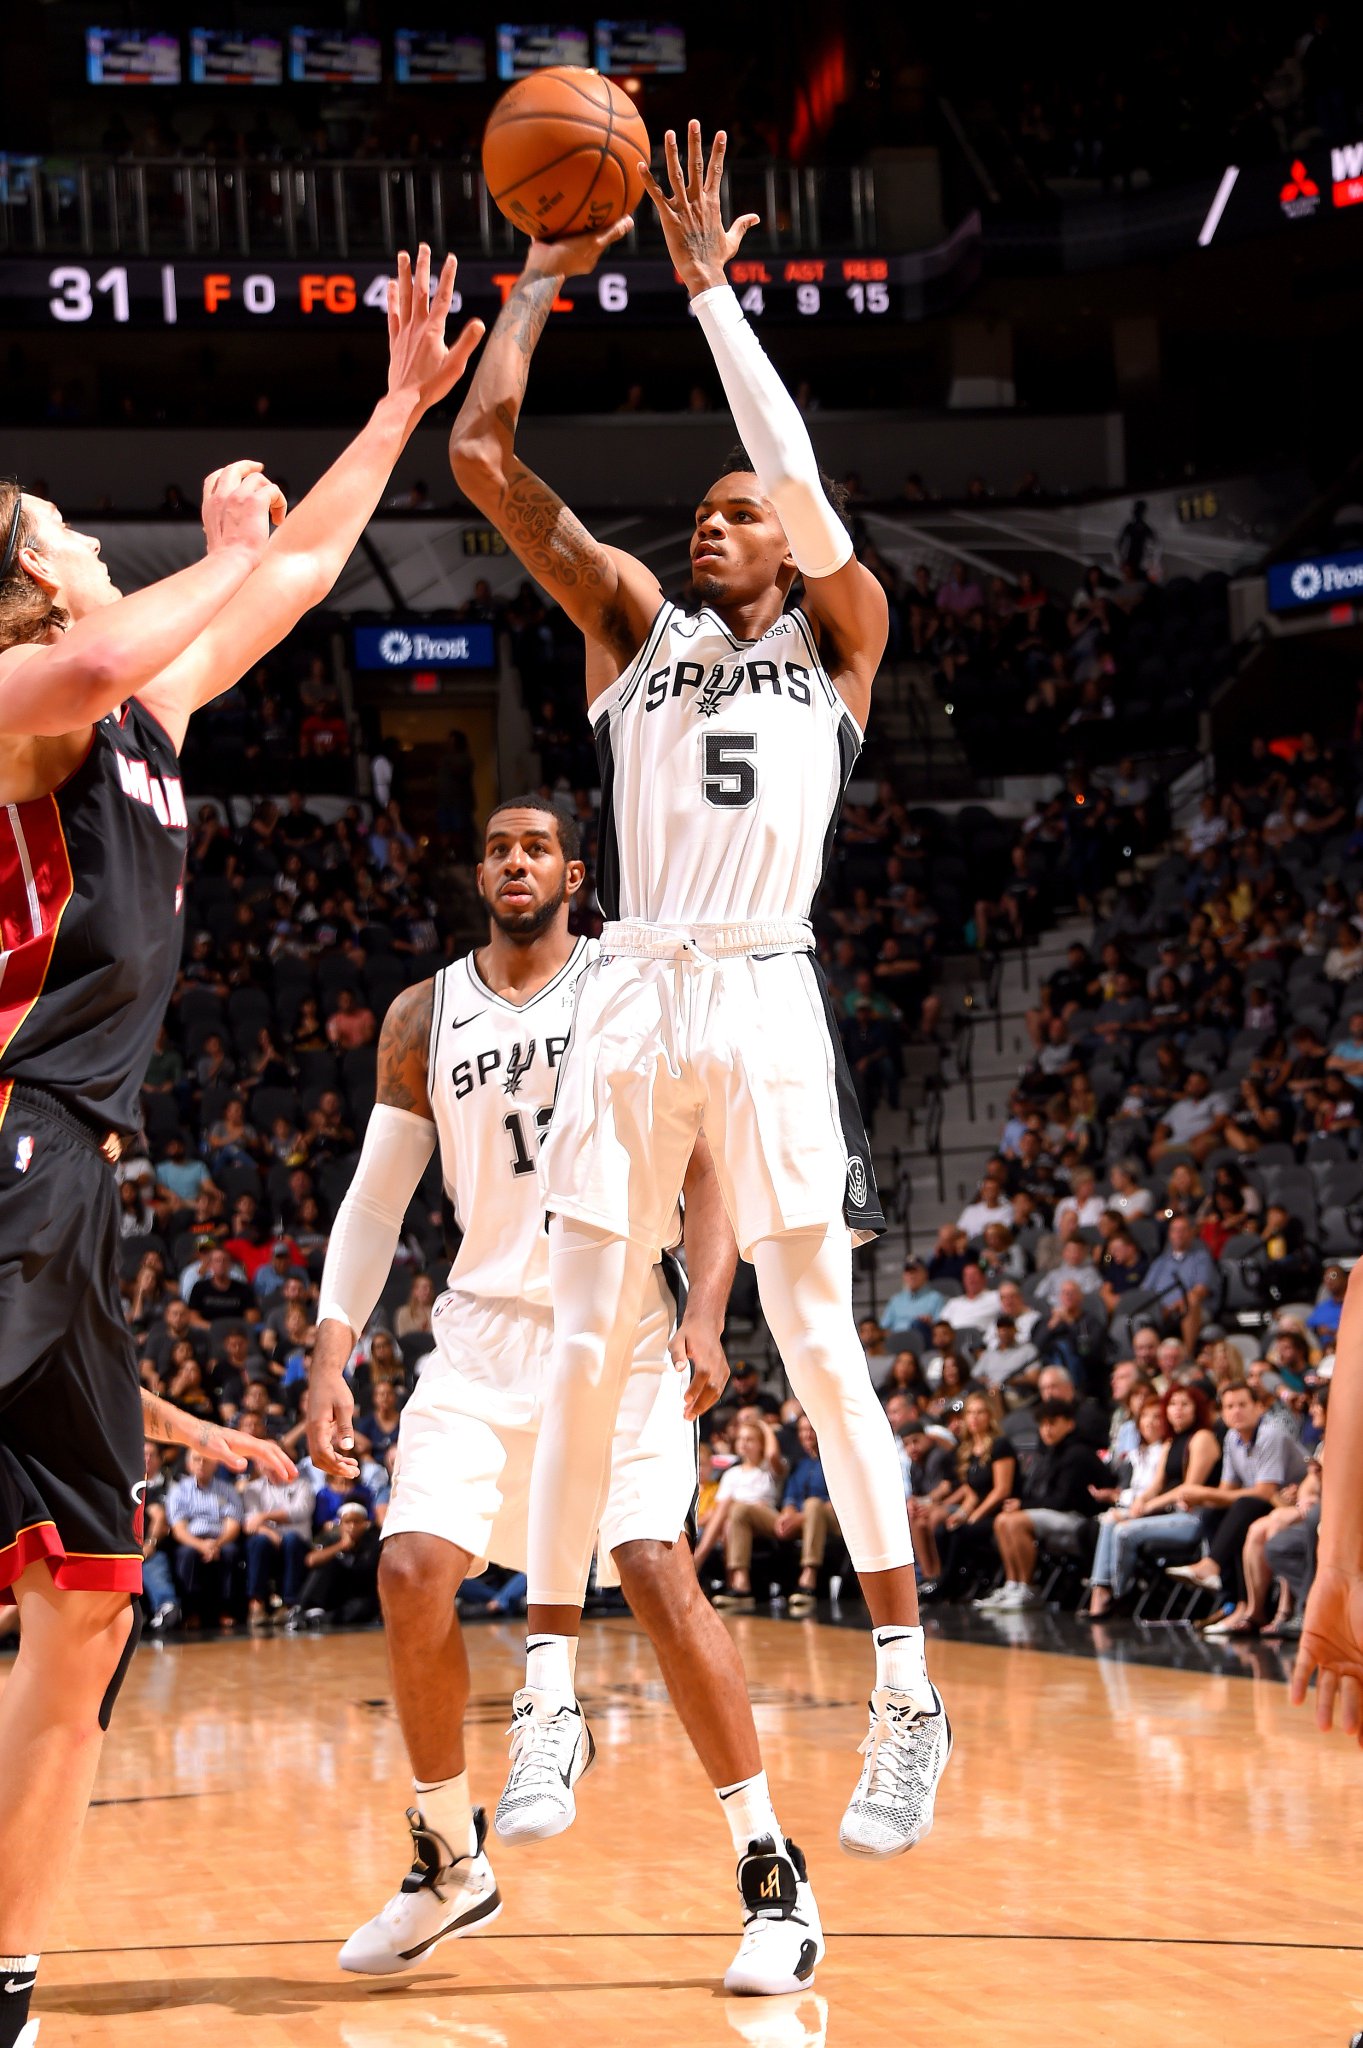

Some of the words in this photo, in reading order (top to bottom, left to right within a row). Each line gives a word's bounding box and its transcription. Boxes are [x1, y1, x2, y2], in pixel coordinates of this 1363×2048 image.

[784, 261, 825, 282] AST
[49, 266, 129, 322] 31
[203, 274, 231, 314] F
[300, 275, 356, 313] FG
[491, 275, 574, 312] TL
[598, 273, 628, 312] 6
[741, 285, 764, 315] 4
[797, 285, 820, 315] 9
[846, 283, 889, 313] 15
[412, 634, 470, 661] Frost
[759, 623, 792, 642] ost
[645, 660, 811, 718] SPURS
[702, 732, 758, 810] 5
